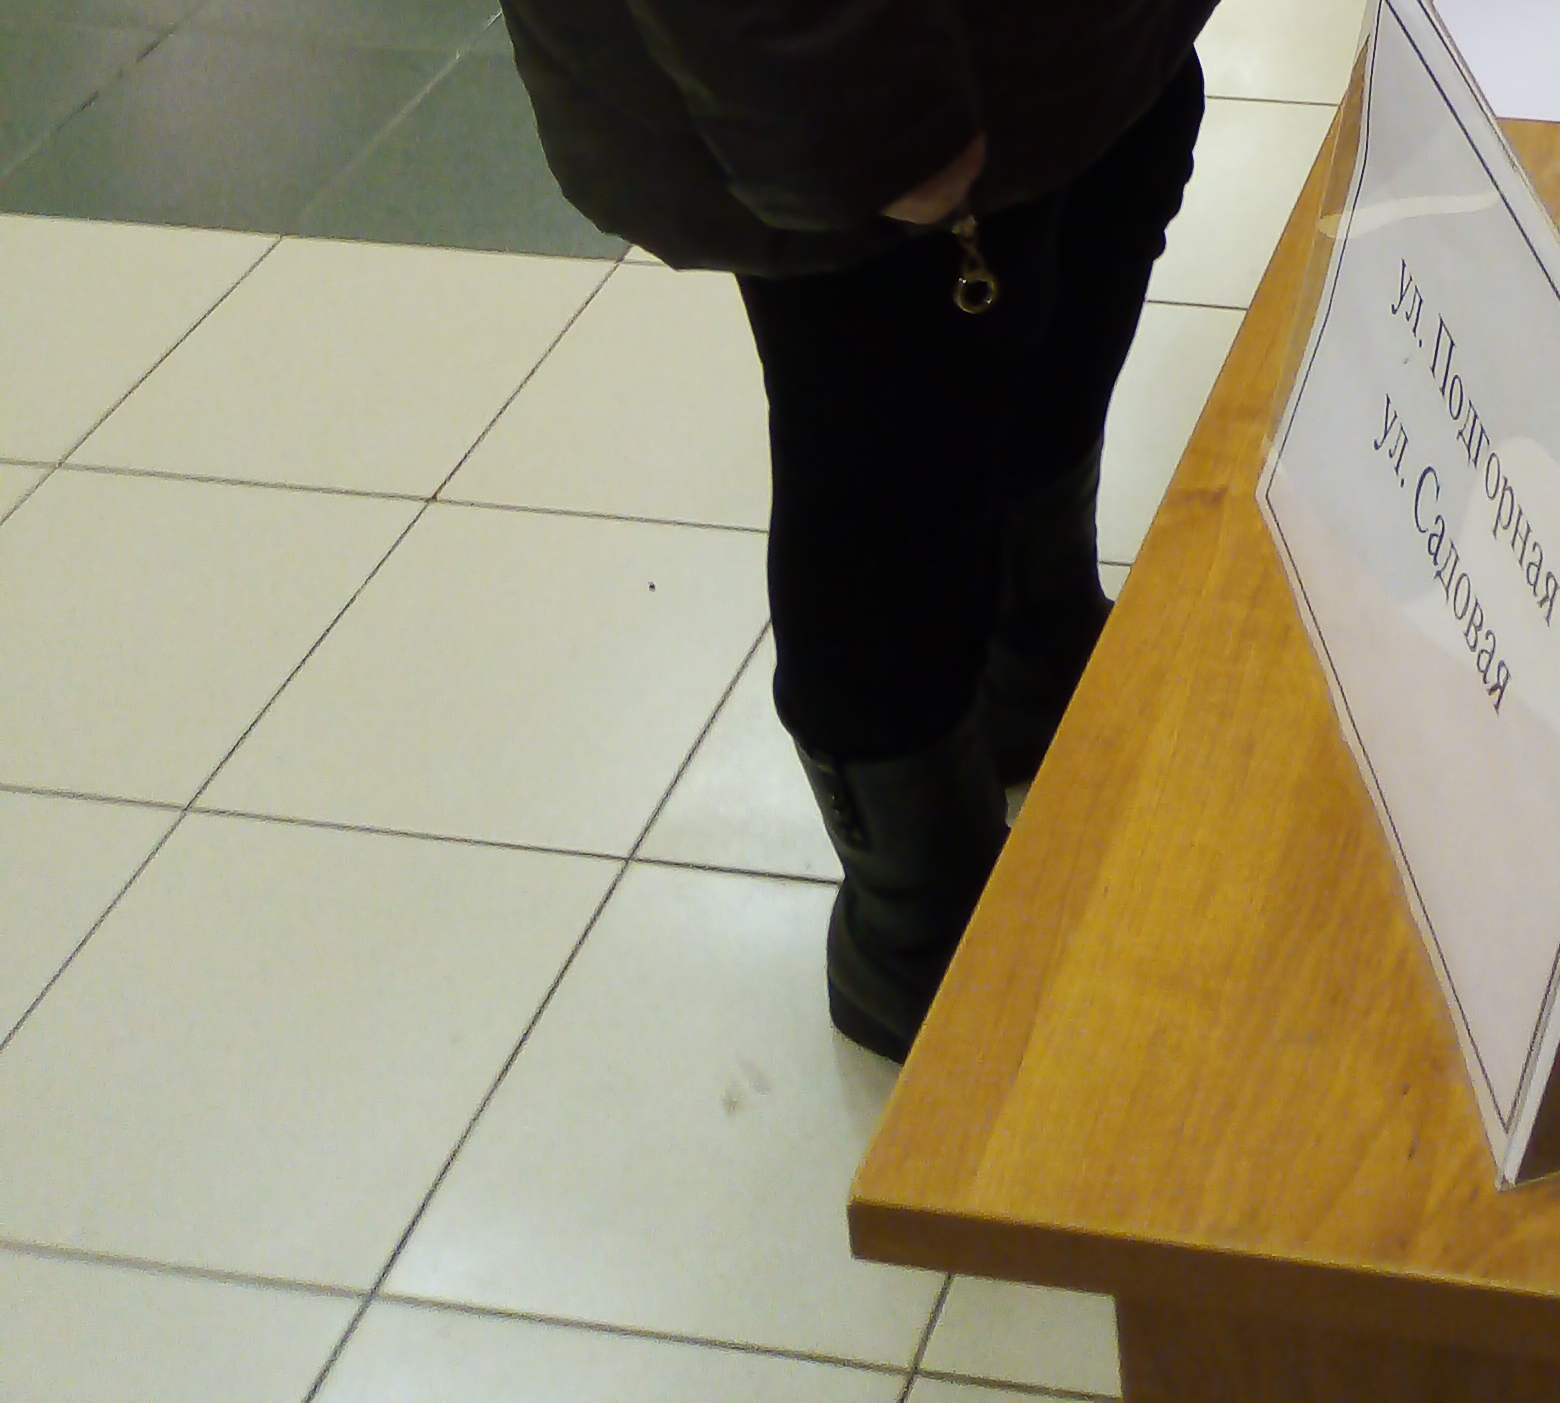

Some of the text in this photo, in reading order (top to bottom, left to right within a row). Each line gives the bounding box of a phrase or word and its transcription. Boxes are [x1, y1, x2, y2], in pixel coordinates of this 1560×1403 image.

[1374, 393, 1512, 716] ул. Садовая
[1391, 258, 1560, 627] ул. Подгорная
